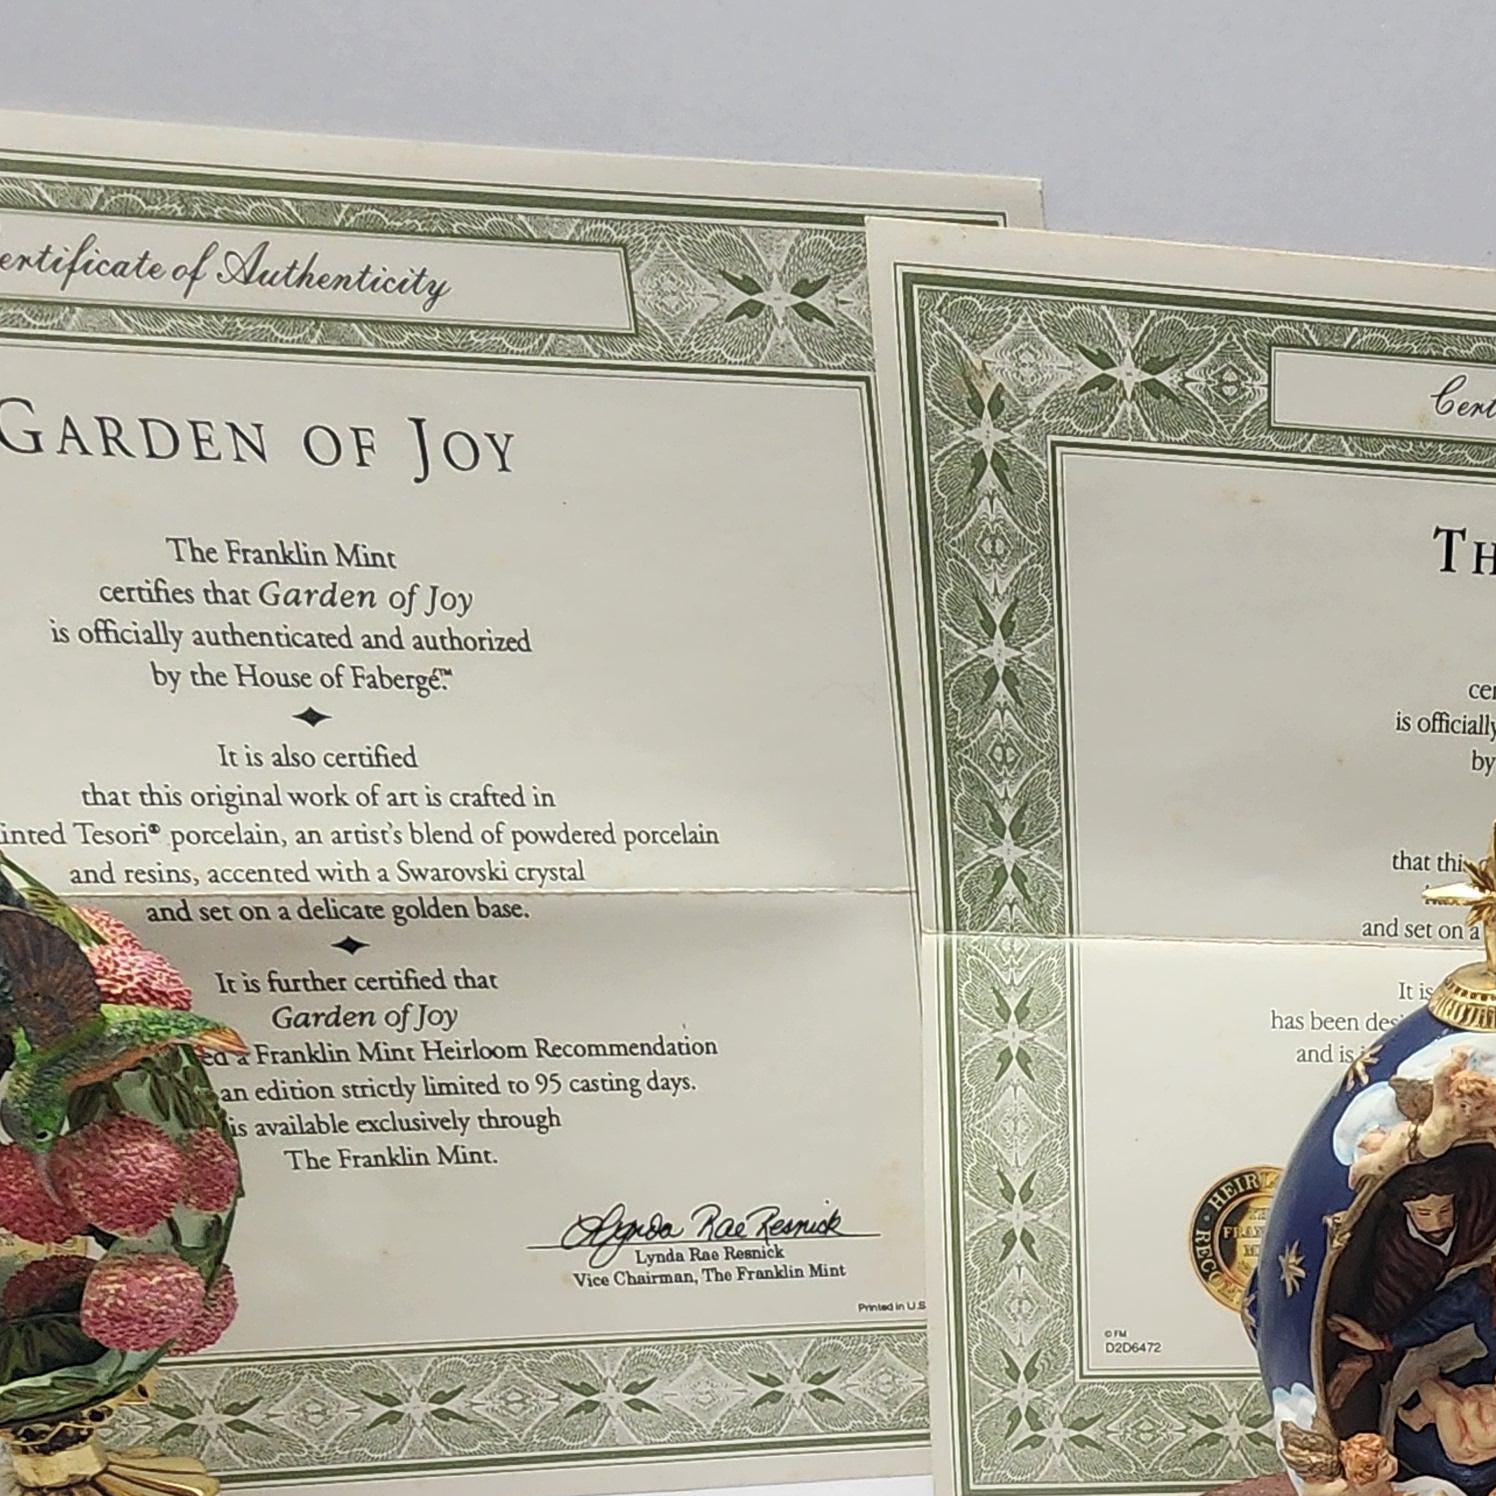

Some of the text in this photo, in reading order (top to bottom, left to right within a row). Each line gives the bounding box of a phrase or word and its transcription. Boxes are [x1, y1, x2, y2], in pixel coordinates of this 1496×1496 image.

[0, 233, 451, 313] ertificate of Authenticity
[0, 397, 514, 483] GARDEN OF JOY
[166, 537, 397, 569] The Franklin Mint
[100, 578, 472, 618] certifies that Garden Joy
[78, 618, 532, 653] officially authenticated and authorized
[234, 664, 312, 688] House
[272, 744, 419, 768] also certified
[1472, 750, 1496, 776] by
[81, 782, 526, 814] that this original work crafted
[0, 822, 67, 845] inted
[170, 822, 287, 852] porcelain,
[408, 822, 474, 844] blend
[511, 822, 616, 851] powdered
[624, 822, 719, 851] porcelain
[70, 859, 585, 888] and resins, accented with Swarovski crystal
[1393, 850, 1430, 871] that
[146, 894, 529, 926] and set delicate golden base.
[1363, 918, 1398, 937] and
[1405, 924, 1432, 938] set
[1439, 925, 1463, 939] on
[215, 968, 498, 993] It further certified that
[272, 1004, 457, 1031] Garden Joy
[1272, 1010, 1304, 1030] has
[1311, 1011, 1359, 1031] been
[253, 1042, 351, 1064] Franklin
[357, 1042, 416, 1062] Mint
[420, 1038, 528, 1060] Heirloom
[534, 1035, 718, 1058] Recommendation
[1297, 1044, 1333, 1062] and
[255, 1070, 696, 1104] edition strictly limited 95 casting days.
[255, 1106, 561, 1136] available exclusively through
[284, 1145, 497, 1170] The Franklin Mint.
[691, 1204, 748, 1238] Rae
[746, 1200, 847, 1245] Resnick
[636, 1244, 785, 1265] Lynda Rae Resnick
[573, 1264, 846, 1287] Vice Chairman, The Franklin Mint
[858, 1303, 893, 1313] Printed
[1106, 1343, 1161, 1353] D2D6472
